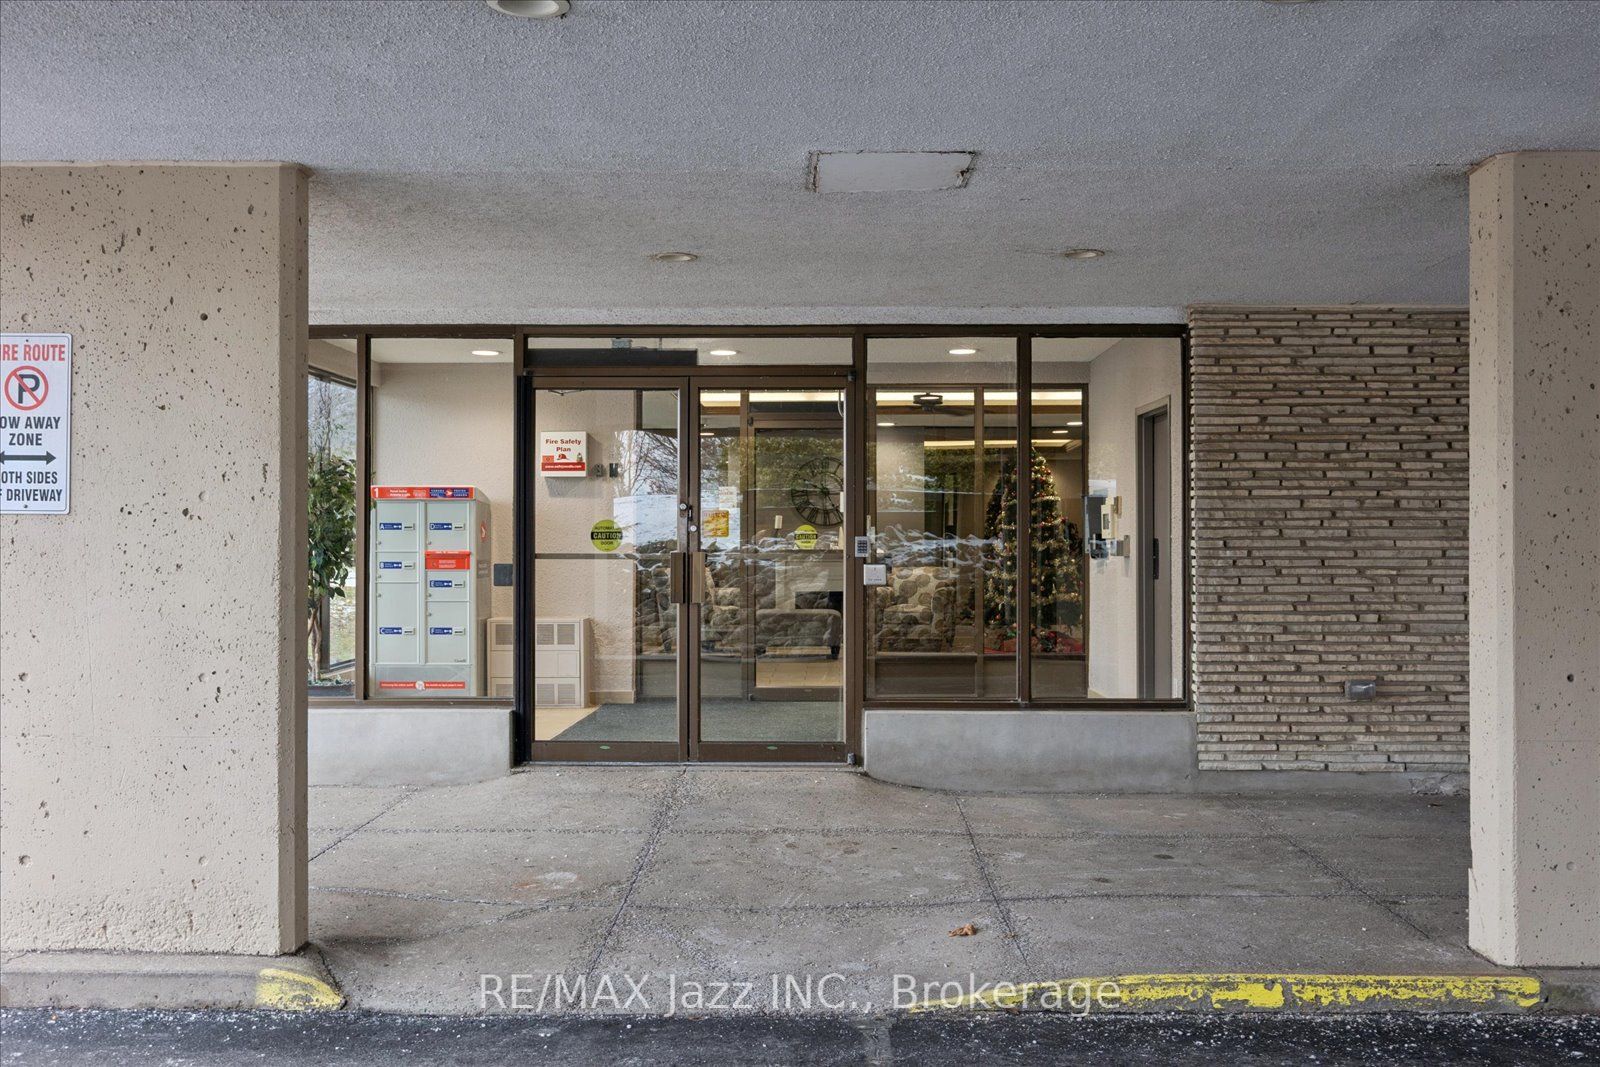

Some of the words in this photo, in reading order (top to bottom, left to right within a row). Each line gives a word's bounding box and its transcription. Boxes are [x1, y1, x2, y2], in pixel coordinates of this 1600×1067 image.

[0, 344, 18, 361] RE
[24, 344, 66, 361] ROUTE
[18, 374, 40, 404] P
[0, 416, 20, 430] OW
[24, 416, 61, 430] AWAY
[9, 433, 43, 446] ZONE
[560, 438, 582, 446] Safety
[1, 471, 22, 484] OTH
[26, 471, 58, 484] SIDES
[6, 489, 63, 501] DRIVEWAY
[374, 487, 379, 498] 1
